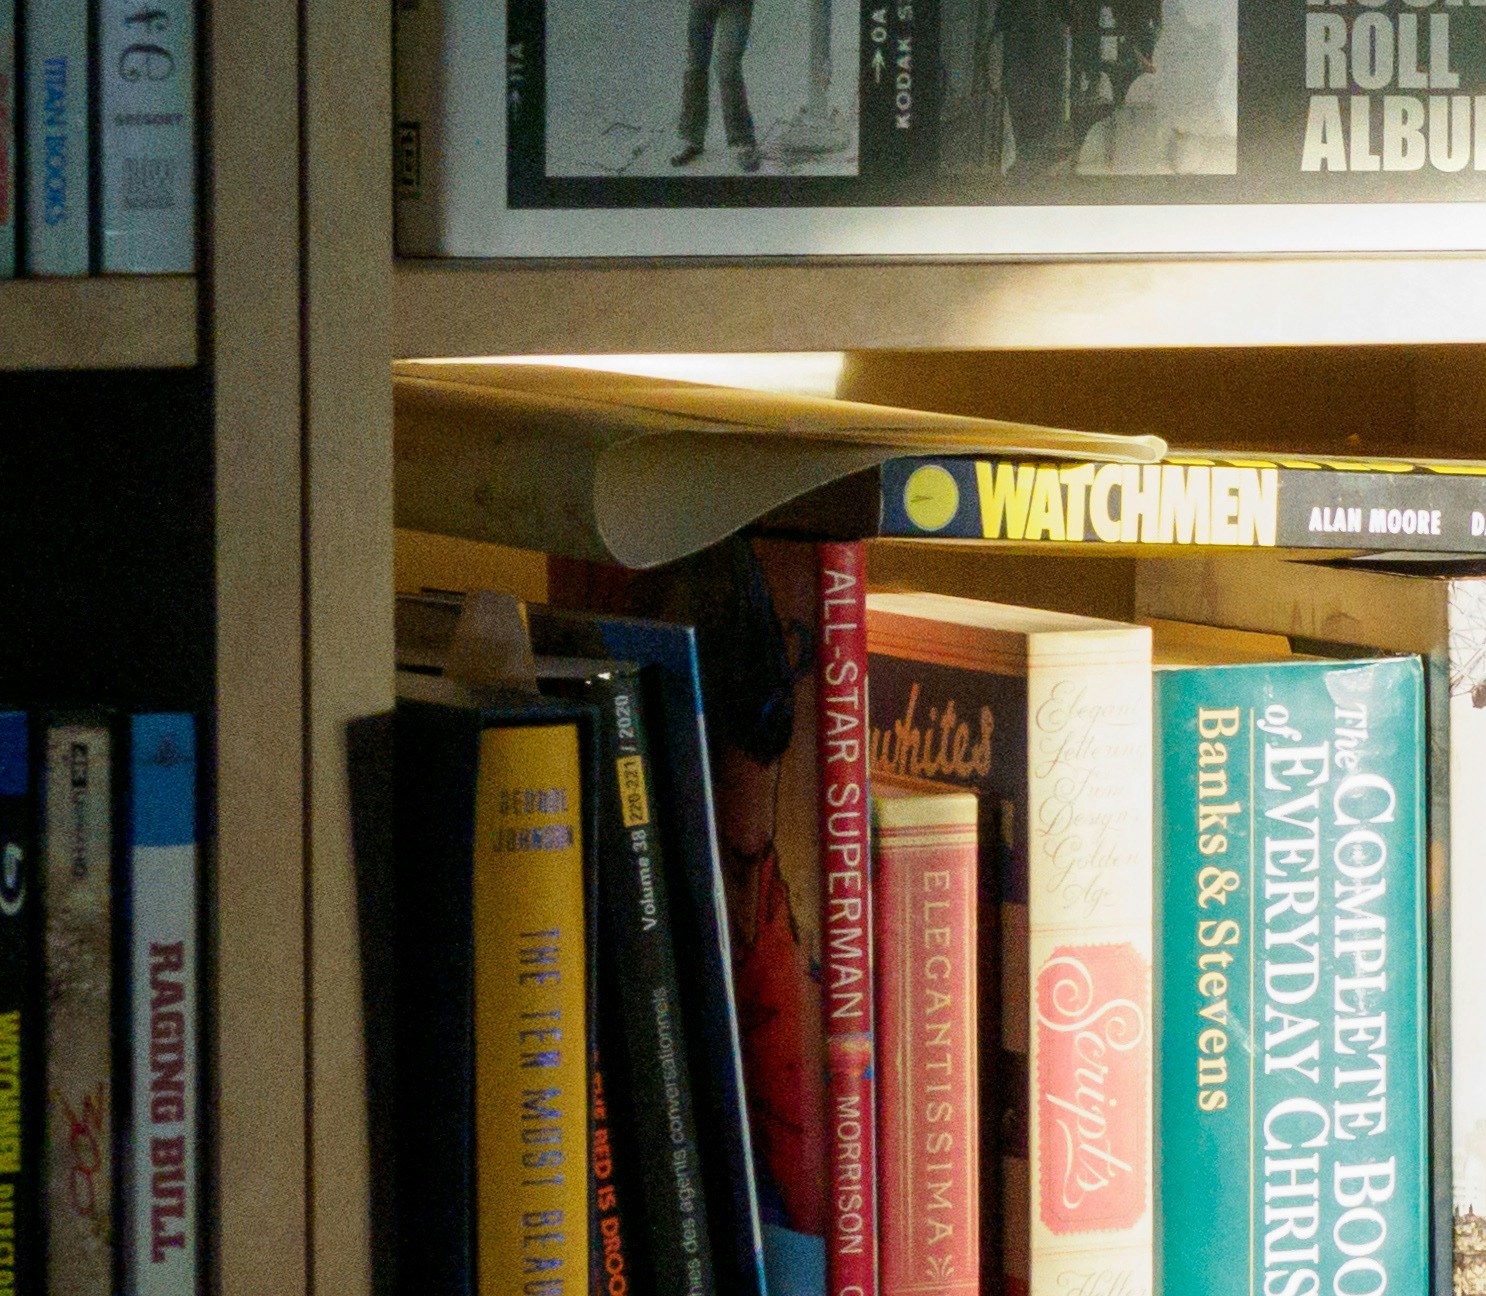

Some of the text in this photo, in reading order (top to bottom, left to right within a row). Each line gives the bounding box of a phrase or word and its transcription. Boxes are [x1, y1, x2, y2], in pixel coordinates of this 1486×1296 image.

[870, 7, 887, 43] 0A
[895, 36, 914, 131] KODAK
[1303, 12, 1460, 90] ROLL
[42, 57, 71, 226] TITAN BOOKS
[975, 460, 1278, 548] WATCHMEN
[1308, 506, 1366, 535] ALAN
[1369, 509, 1441, 539] MOORE
[823, 568, 862, 763] ALL-STAR
[1261, 703, 1302, 746] of
[1330, 702, 1369, 771] The
[518, 926, 561, 987] THE
[827, 782, 864, 1020] SUPERMAN
[1194, 705, 1242, 1112] Banks & Stevens
[1259, 744, 1330, 1081] EVERYDAY
[1330, 772, 1396, 1140] COMPLETE
[149, 941, 187, 1263] RAGING BULL
[519, 1011, 563, 1070] TEN
[921, 868, 956, 1247] ELEGANTISSIMA
[1037, 956, 1147, 1212] Scripts
[521, 1089, 565, 1191] MOST
[834, 1094, 863, 1257] MORRISON
